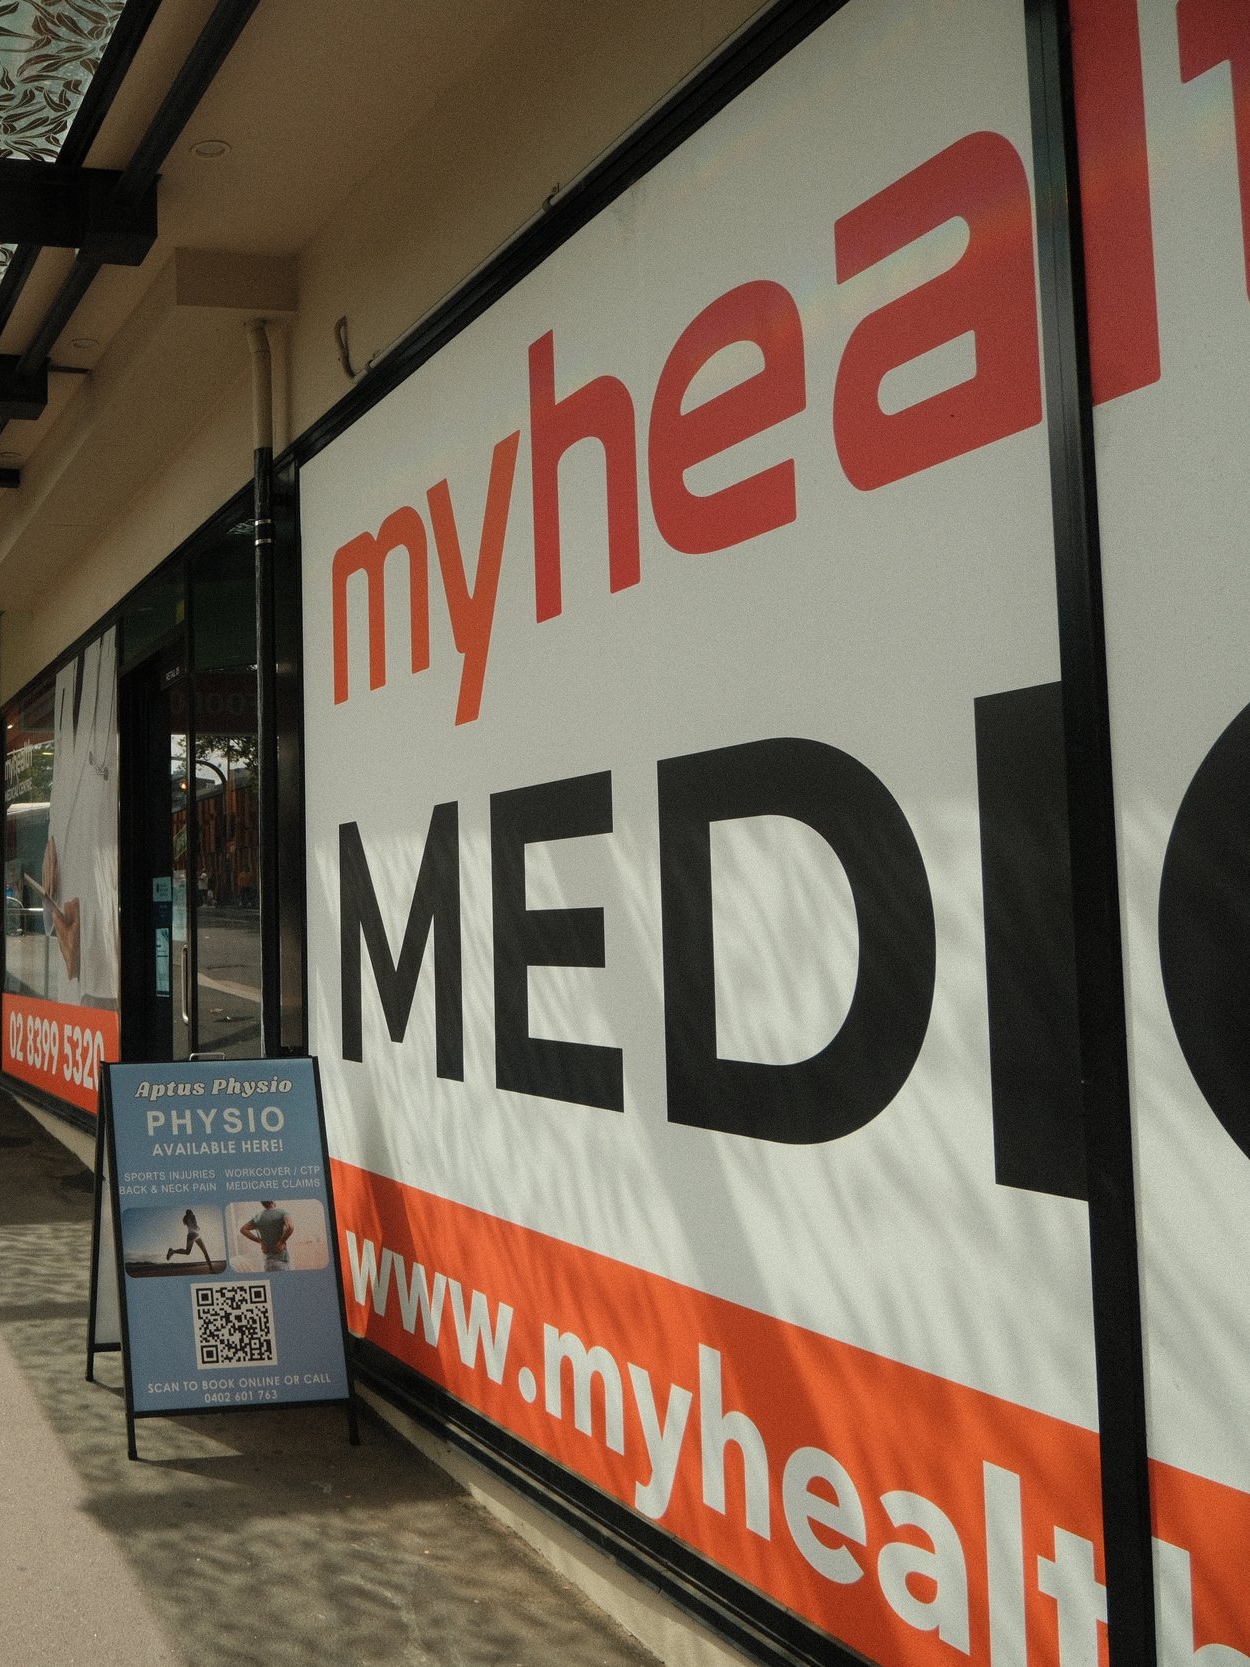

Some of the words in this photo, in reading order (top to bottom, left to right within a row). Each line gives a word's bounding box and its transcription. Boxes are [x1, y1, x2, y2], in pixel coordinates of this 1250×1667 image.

[332, 0, 1250, 726] myheal
[338, 681, 1250, 1203] MEDI
[10, 1010, 24, 1062] 02
[27, 1014, 59, 1075] 8399
[63, 1024, 105, 1092] 5320
[135, 1079, 205, 1101] Aptus
[211, 1076, 293, 1098] Physio
[146, 1106, 285, 1136] PHYSIO
[152, 1141, 236, 1156] AVAILABLE
[242, 1139, 284, 1153] HERE!
[124, 1171, 165, 1182] SPORTS
[169, 1169, 215, 1180] INJURIES
[224, 1167, 291, 1178] WORKCOVER
[300, 1166, 320, 1175] CTP
[119, 1185, 147, 1195] BACK
[151, 1185, 158, 1194] &
[161, 1183, 189, 1193] NECK
[192, 1182, 217, 1192] PAIN
[226, 1180, 278, 1191] MEDICARE
[282, 1178, 320, 1189] CLAIMS
[148, 1382, 180, 1393] SCAN
[183, 1381, 197, 1392] TO
[202, 1379, 235, 1389] BOOK
[238, 1376, 280, 1388] ONLINE
[284, 1375, 300, 1385] OR
[304, 1373, 331, 1384] CALL
[204, 1392, 230, 1403] 0402
[234, 1391, 253, 1401] 601
[258, 1389, 278, 1400] 763
